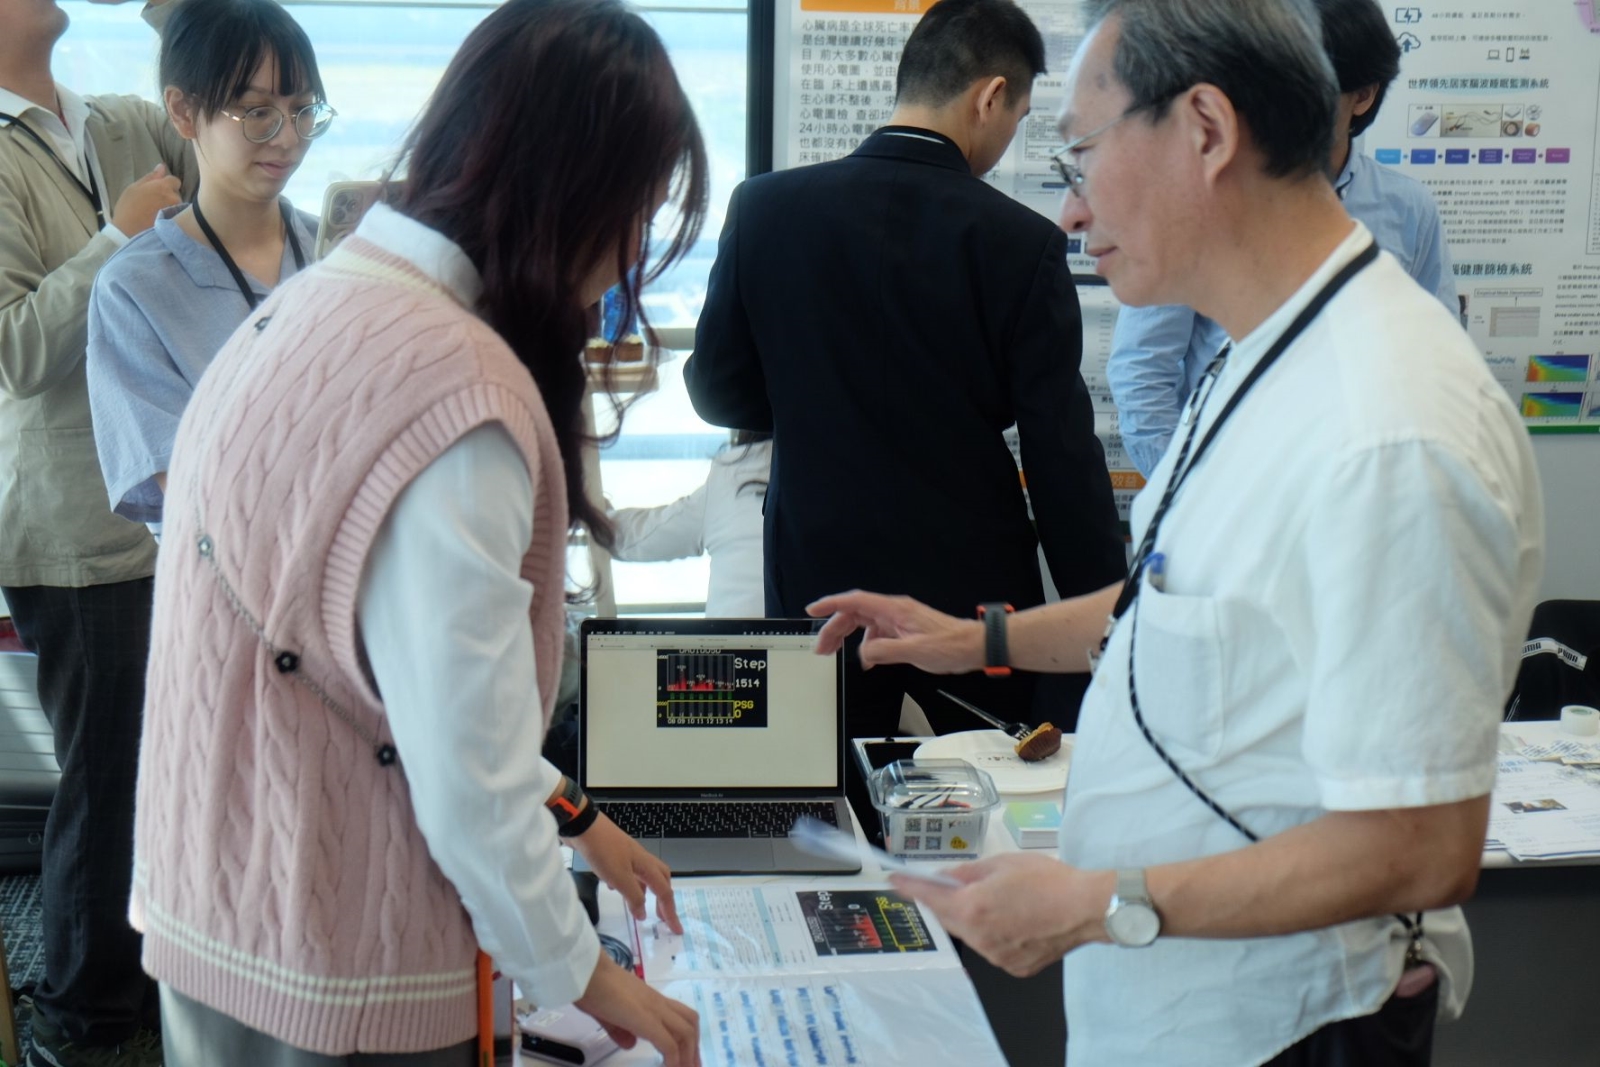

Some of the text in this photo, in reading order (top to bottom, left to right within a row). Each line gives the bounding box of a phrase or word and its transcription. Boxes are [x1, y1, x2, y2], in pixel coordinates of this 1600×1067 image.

[802, 49, 812, 60] 目
[801, 79, 896, 91] 在臨 床上遭遇最
[1408, 78, 1550, 90] 世界領先居家腦波睡眠監測系統
[801, 108, 848, 120] 心電圖檢
[799, 122, 881, 135] 24小時心電圖
[800, 137, 863, 150] 也都沒有發
[799, 151, 846, 163] 床確診
[1522, 642, 1579, 663] UMA PUMA
[734, 657, 767, 671] Step
[735, 678, 760, 688] 1514
[734, 700, 754, 709] PSG
[816, 890, 834, 911] Step
